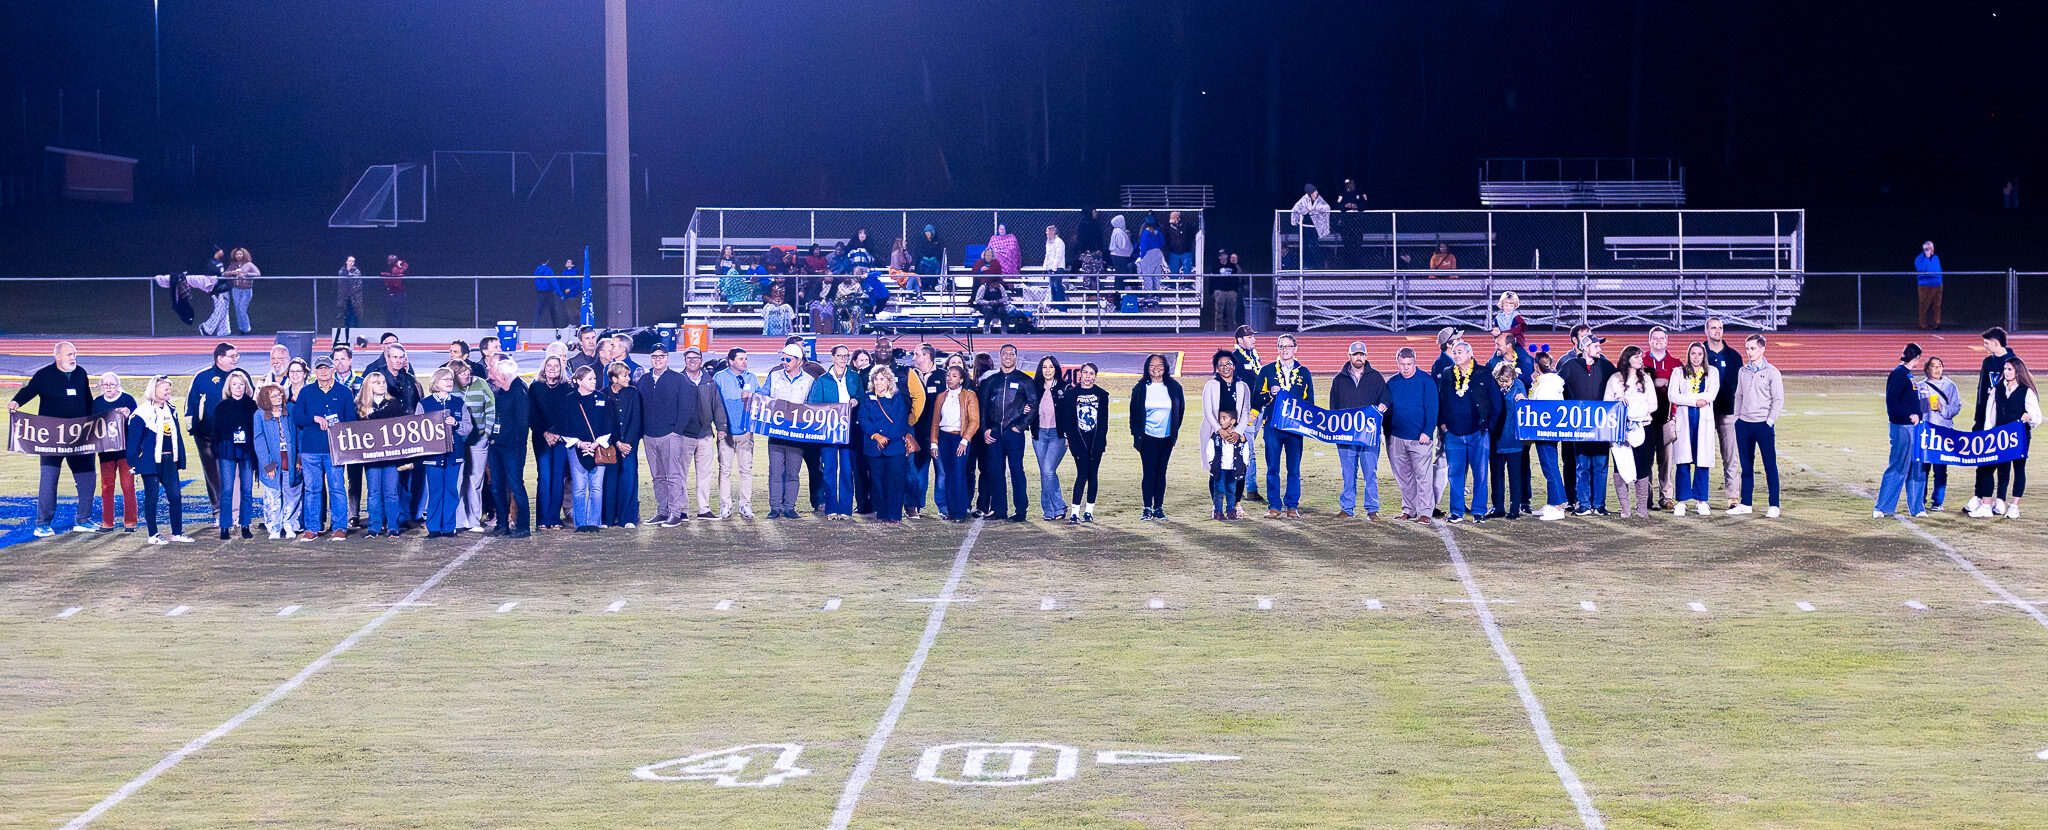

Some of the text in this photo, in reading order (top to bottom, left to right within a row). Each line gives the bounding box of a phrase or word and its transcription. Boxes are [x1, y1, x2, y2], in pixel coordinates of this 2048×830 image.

[750, 399, 849, 431] the 1990s
[1281, 398, 1376, 433] the 2000s
[1517, 404, 1617, 429] the 2010s
[14, 417, 119, 444] the 1970s
[337, 418, 445, 451] the 1980s
[1920, 428, 2018, 455] the 2020s
